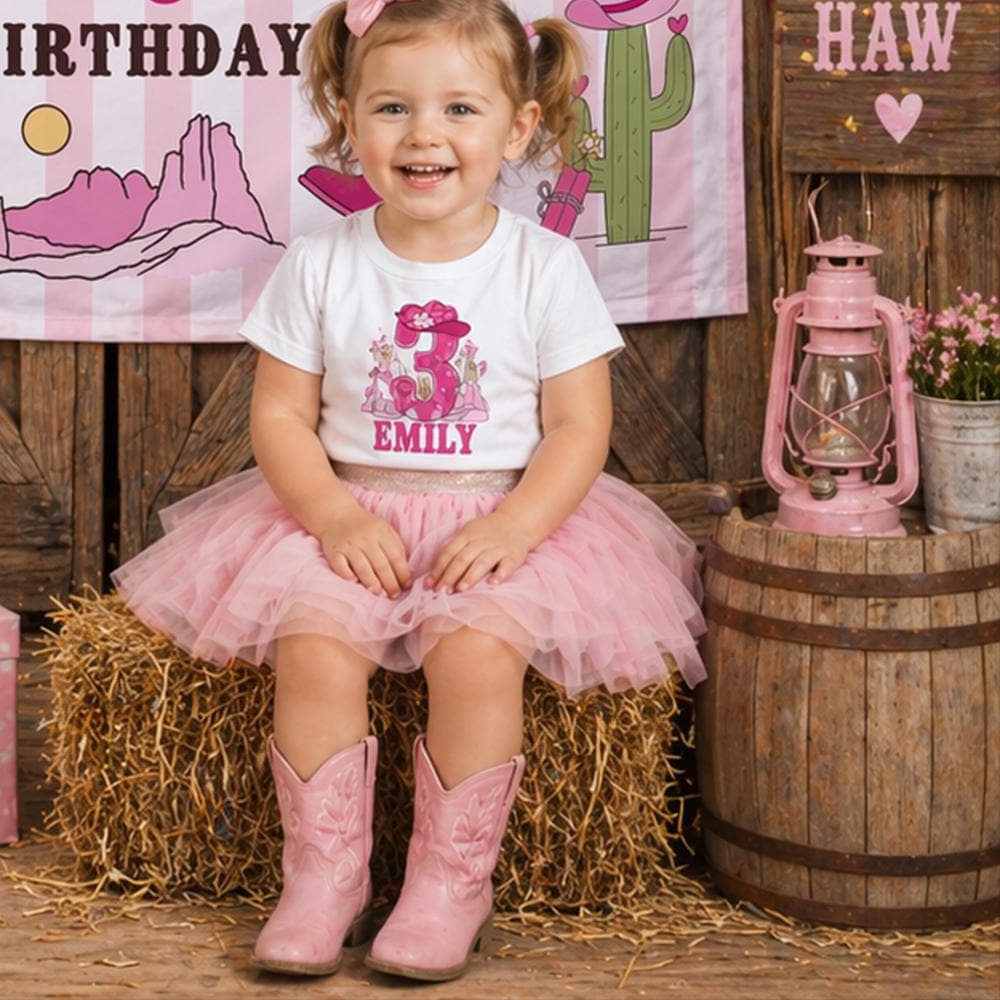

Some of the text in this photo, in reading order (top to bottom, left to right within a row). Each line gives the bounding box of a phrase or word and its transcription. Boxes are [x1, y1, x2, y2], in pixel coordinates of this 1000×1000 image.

[813, 1, 961, 73] HAW
[389, 310, 462, 422] 3
[373, 420, 477, 454] EMILY
